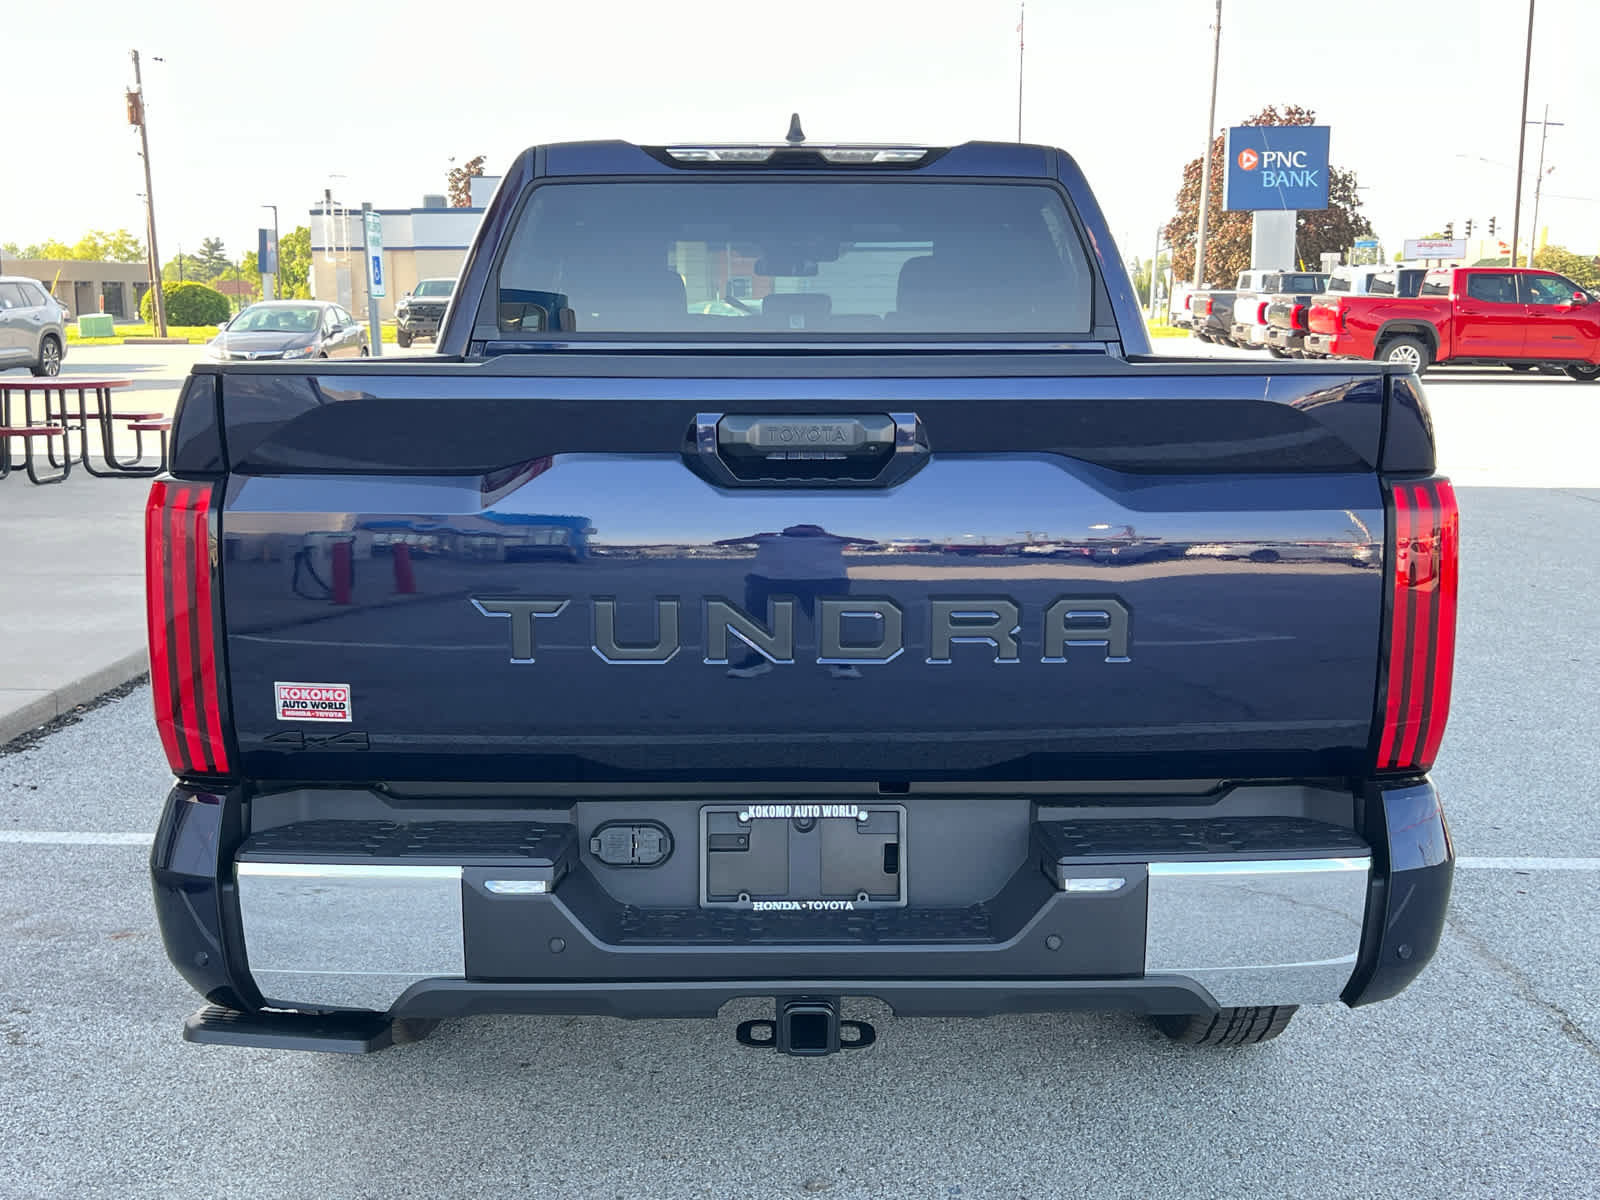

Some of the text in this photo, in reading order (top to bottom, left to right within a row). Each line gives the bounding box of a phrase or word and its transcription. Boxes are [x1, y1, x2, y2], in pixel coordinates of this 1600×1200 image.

[1261, 151, 1307, 169] PNC
[1261, 169, 1320, 188] BANK
[767, 425, 848, 442] TOYOTA
[471, 596, 1132, 665] TUNDRA
[280, 687, 347, 701] KOKOMO
[282, 700, 346, 711] AUTO WORLD
[748, 804, 859, 818] KOKOMO AUTO WORLD
